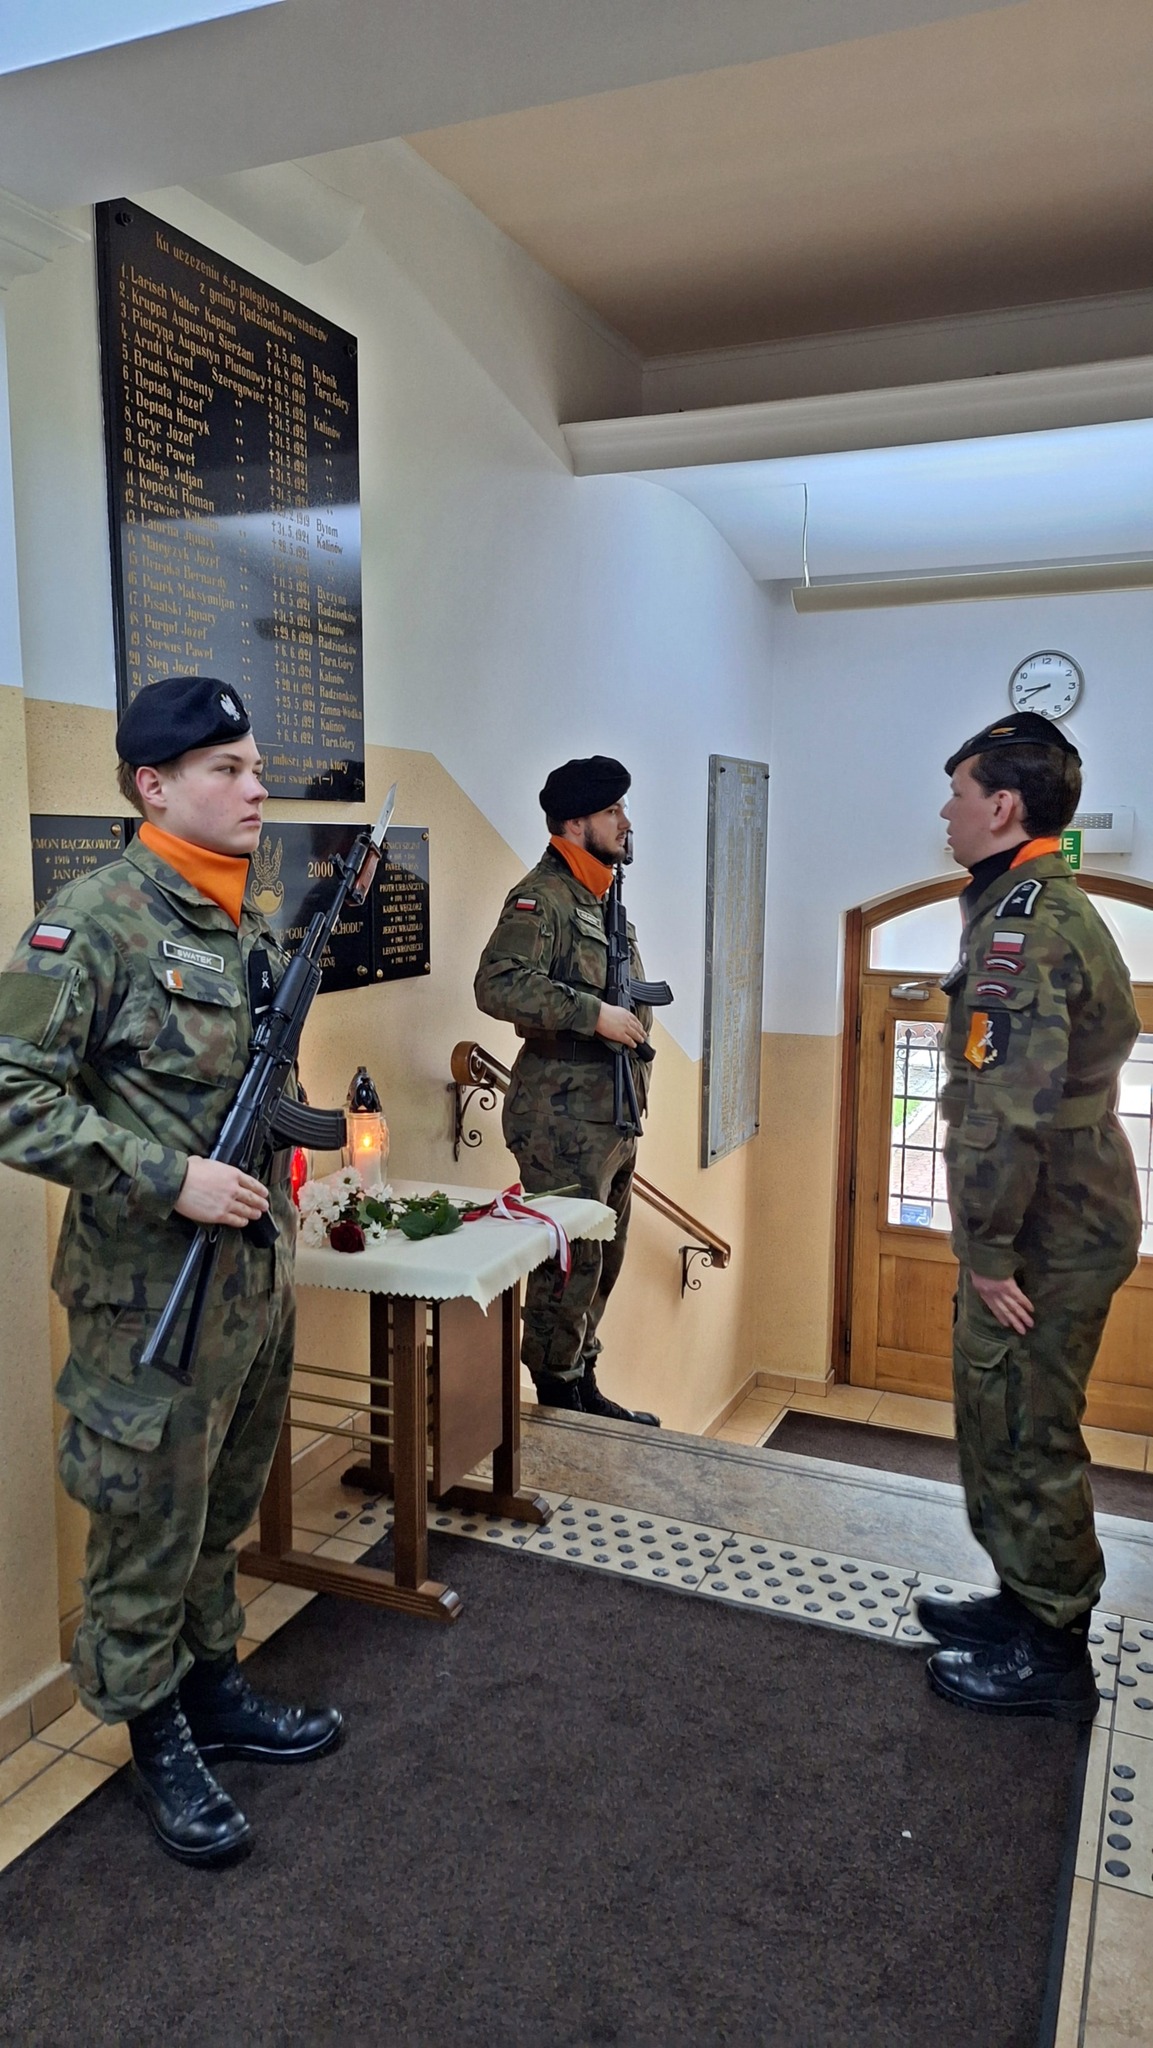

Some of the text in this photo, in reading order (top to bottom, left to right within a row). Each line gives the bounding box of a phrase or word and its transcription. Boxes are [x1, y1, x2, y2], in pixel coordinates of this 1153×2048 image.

[155, 231, 170, 254] Ku
[173, 245, 220, 283] uczczeniu
[131, 287, 168, 320] Kruppa
[171, 308, 215, 344] Augustyn
[199, 282, 205, 295] z
[209, 286, 237, 314] gminy
[130, 266, 167, 300] Larisch
[170, 288, 200, 318] Walter
[312, 365, 338, 391] Rybnik
[132, 308, 174, 343] Pietryga
[177, 331, 221, 365] Augustyn
[225, 355, 267, 389] Plutonowy
[133, 329, 163, 356] Arndt
[211, 367, 265, 405] Szeregowiec
[134, 350, 169, 379] Brudis
[172, 367, 214, 401] Wincenty
[177, 389, 205, 414] Józef
[136, 412, 162, 435] Gryc
[166, 424, 194, 448] Józef
[176, 409, 210, 436] Henryk
[137, 432, 163, 455] Gryc
[166, 443, 196, 468] Paweł
[138, 453, 170, 478] Kaleja
[139, 473, 178, 500] Kopecki
[182, 488, 215, 513] Roman
[61, 839, 121, 851] BĄCZKOWICZ
[52, 868, 71, 880] JAN
[308, 861, 334, 878] 2000
